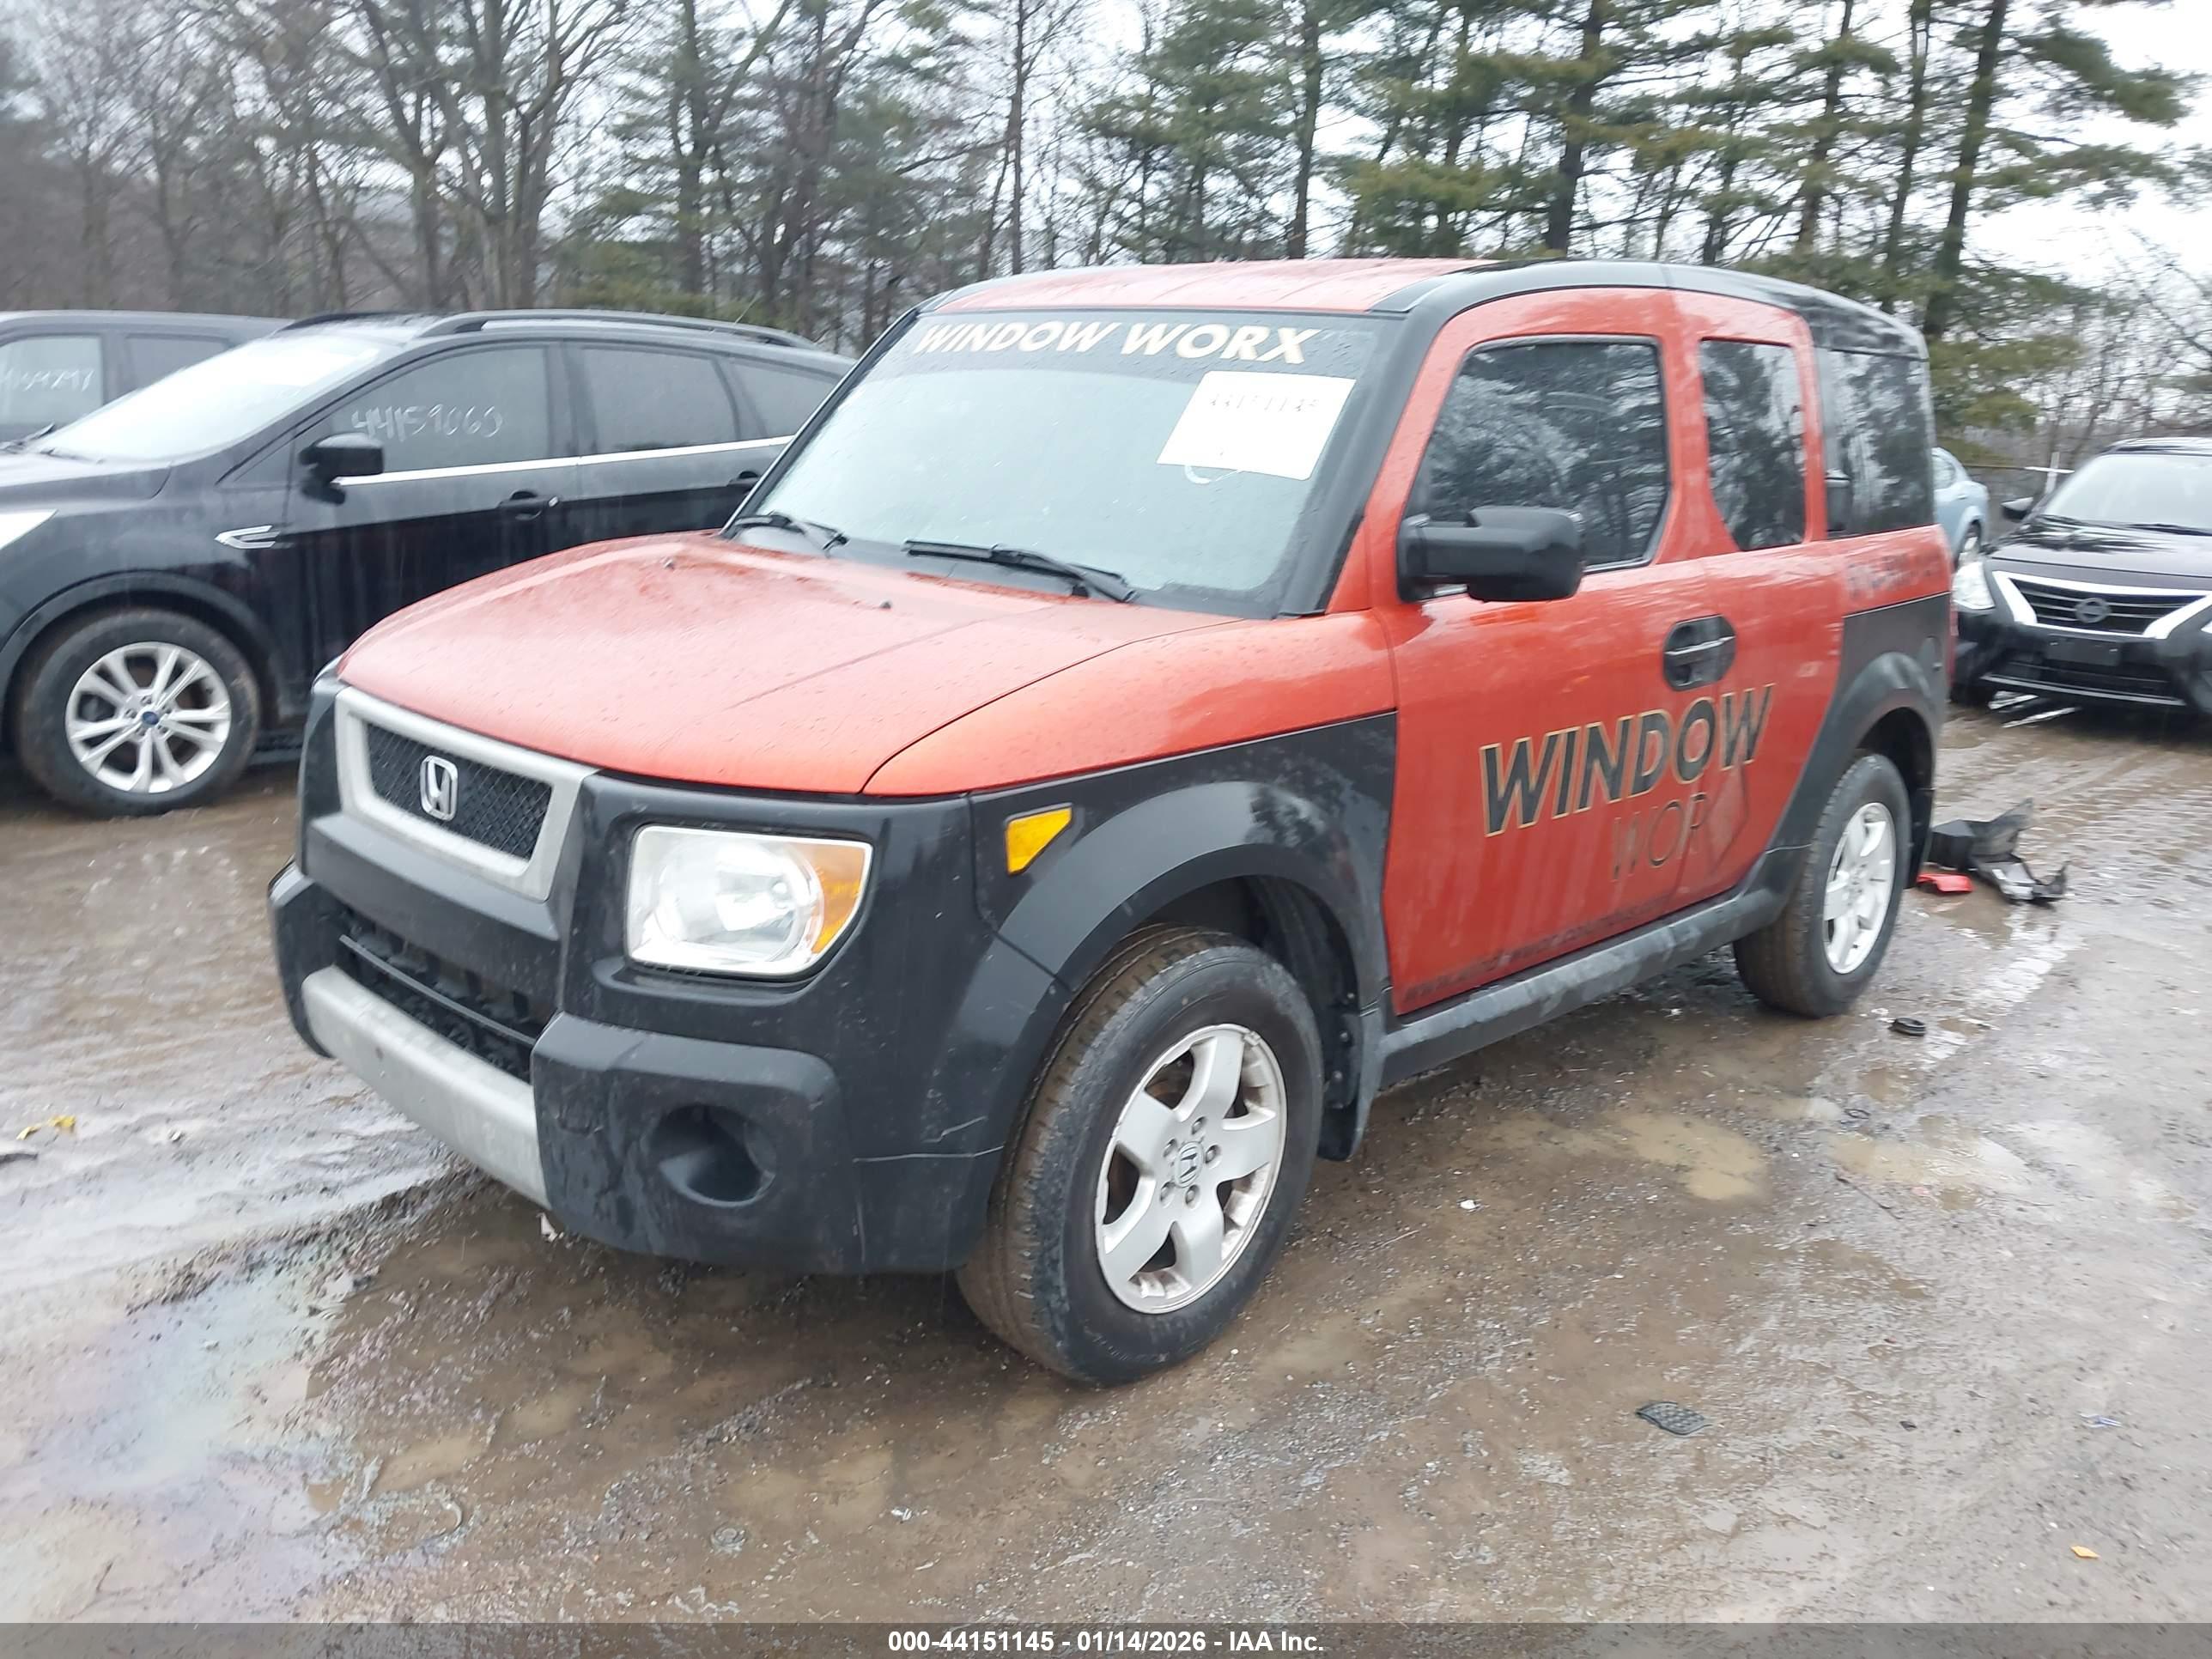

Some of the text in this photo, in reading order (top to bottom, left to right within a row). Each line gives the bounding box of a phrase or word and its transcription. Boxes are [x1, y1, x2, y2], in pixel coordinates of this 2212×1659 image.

[913, 320, 1322, 365] WINDOW WORX
[1480, 683, 1776, 838] WINDOW
